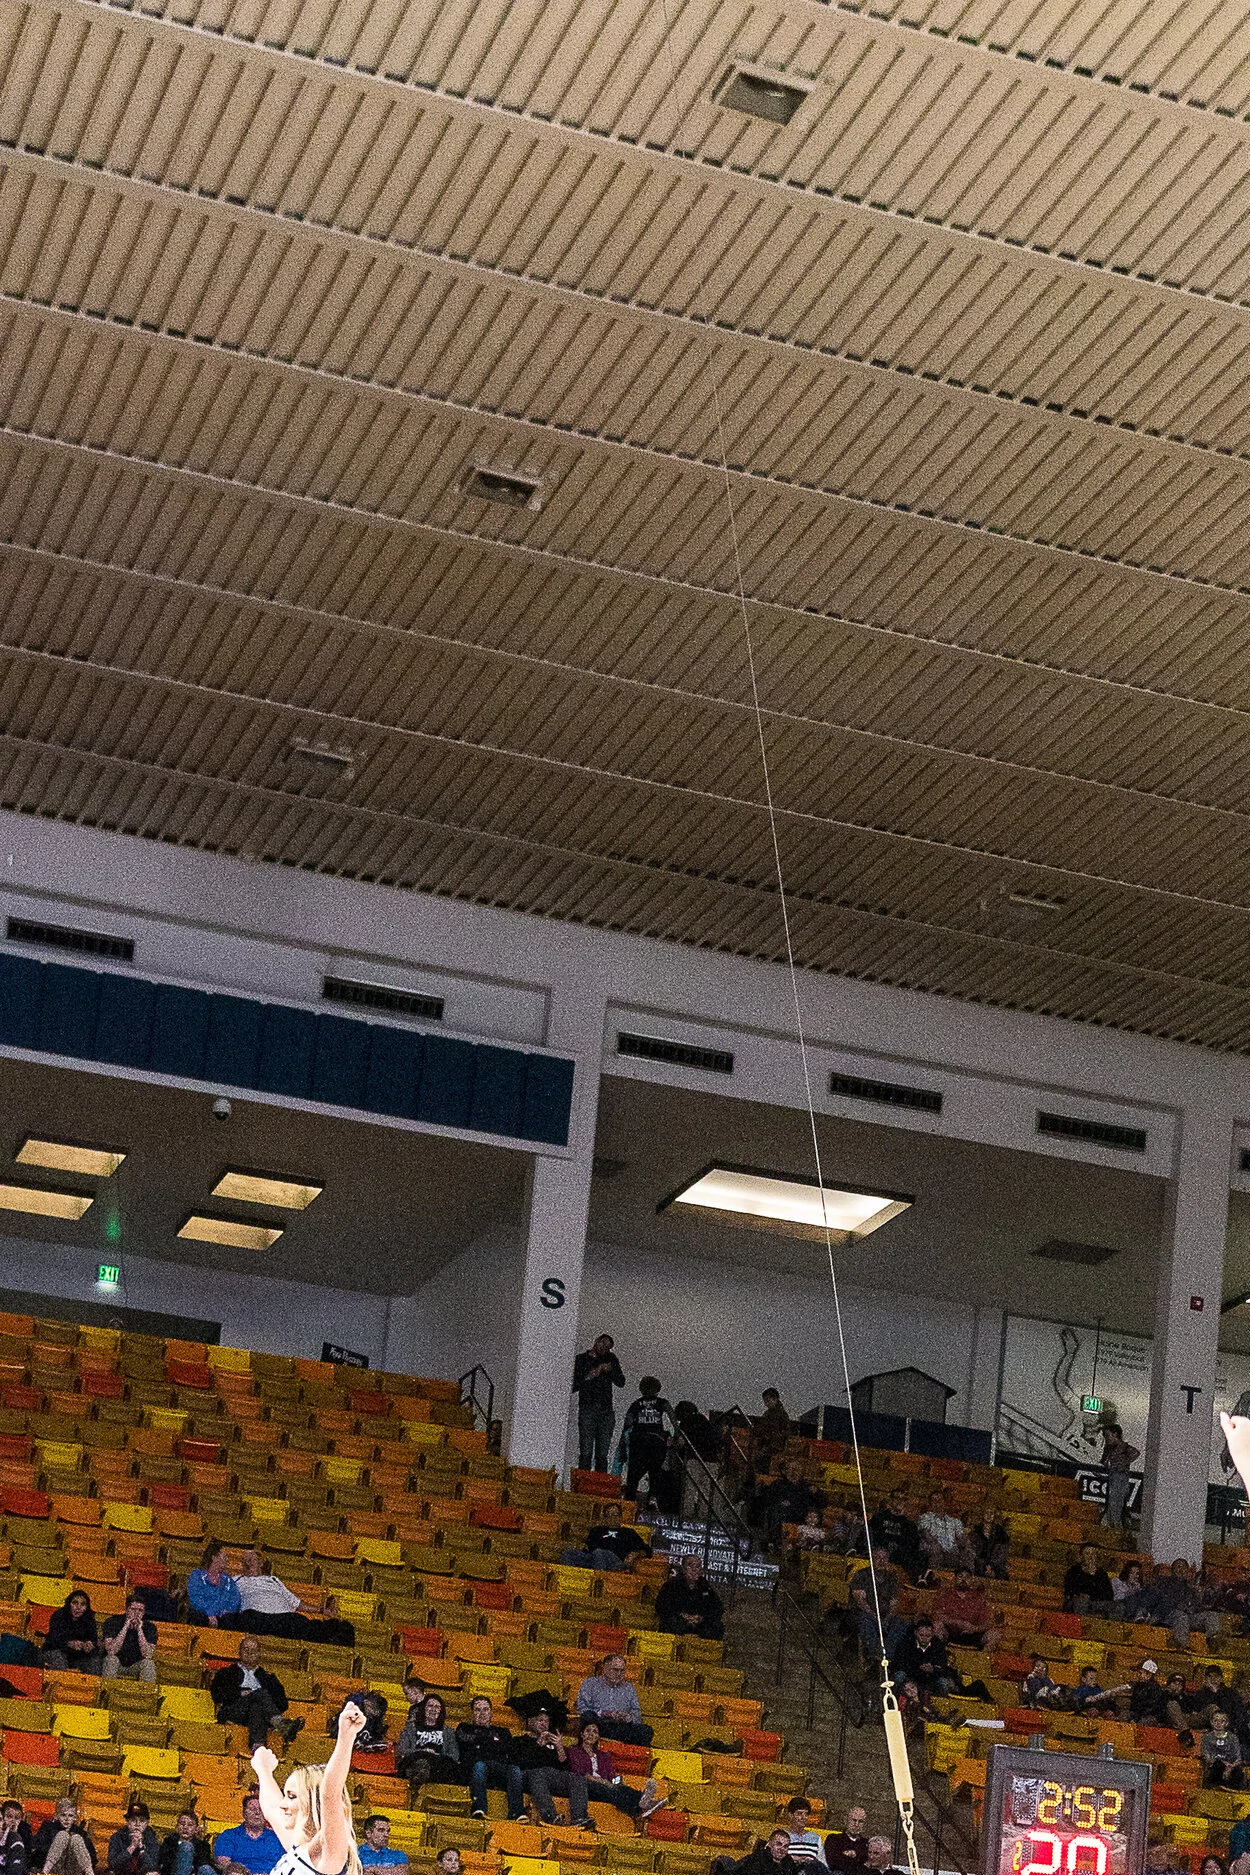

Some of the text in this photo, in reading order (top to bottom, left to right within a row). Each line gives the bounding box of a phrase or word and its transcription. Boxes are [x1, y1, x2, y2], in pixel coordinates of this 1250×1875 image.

[540, 1277, 566, 1309] S
[1180, 1385, 1202, 1414] T
[1038, 1781, 1123, 1832] 2:52
